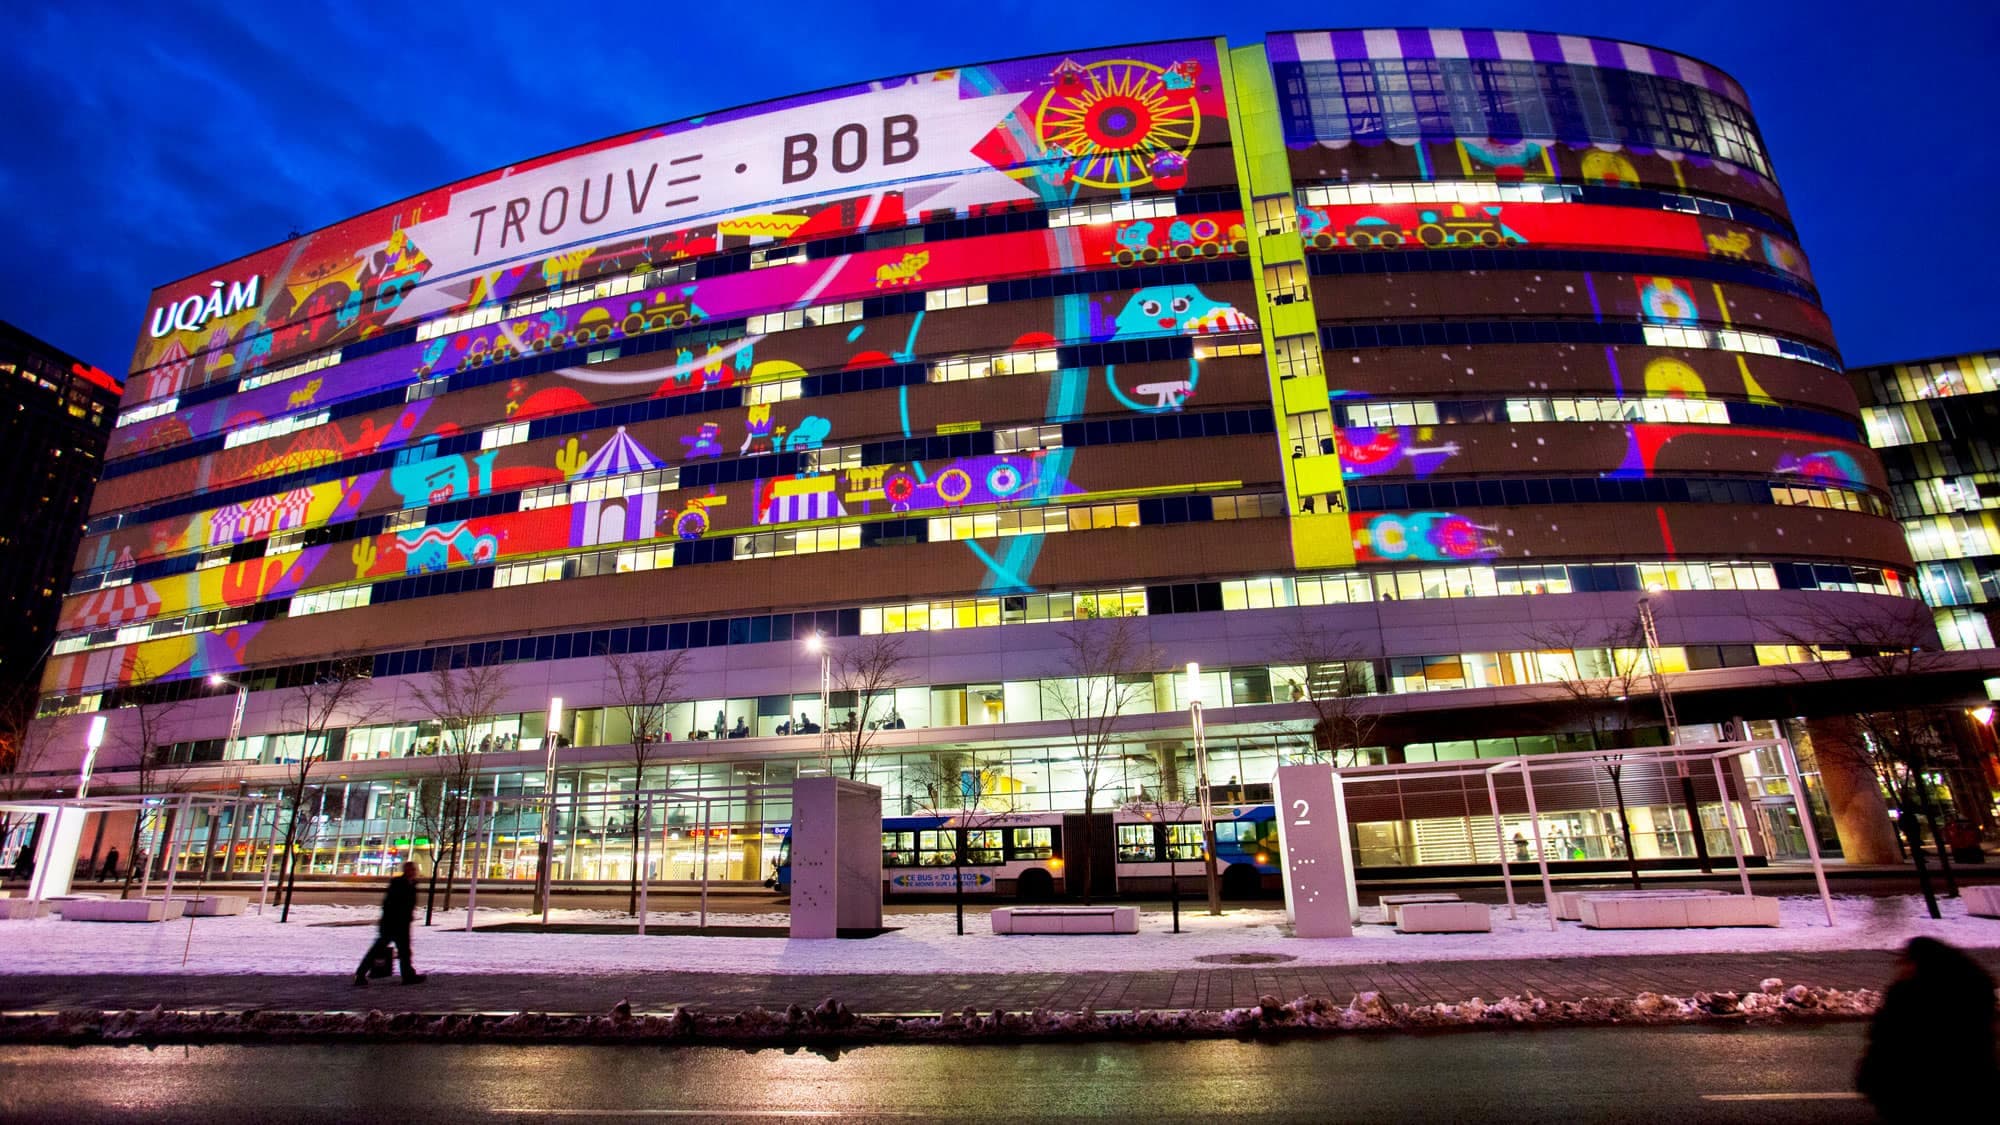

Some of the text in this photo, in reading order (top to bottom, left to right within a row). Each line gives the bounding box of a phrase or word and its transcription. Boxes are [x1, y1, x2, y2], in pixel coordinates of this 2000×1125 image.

[470, 113, 920, 256] TROUVE BOB
[150, 274, 259, 338] UQÀM
[1292, 799, 1311, 826] 2
[917, 873, 933, 881] BUS
[941, 873, 950, 881] 70
